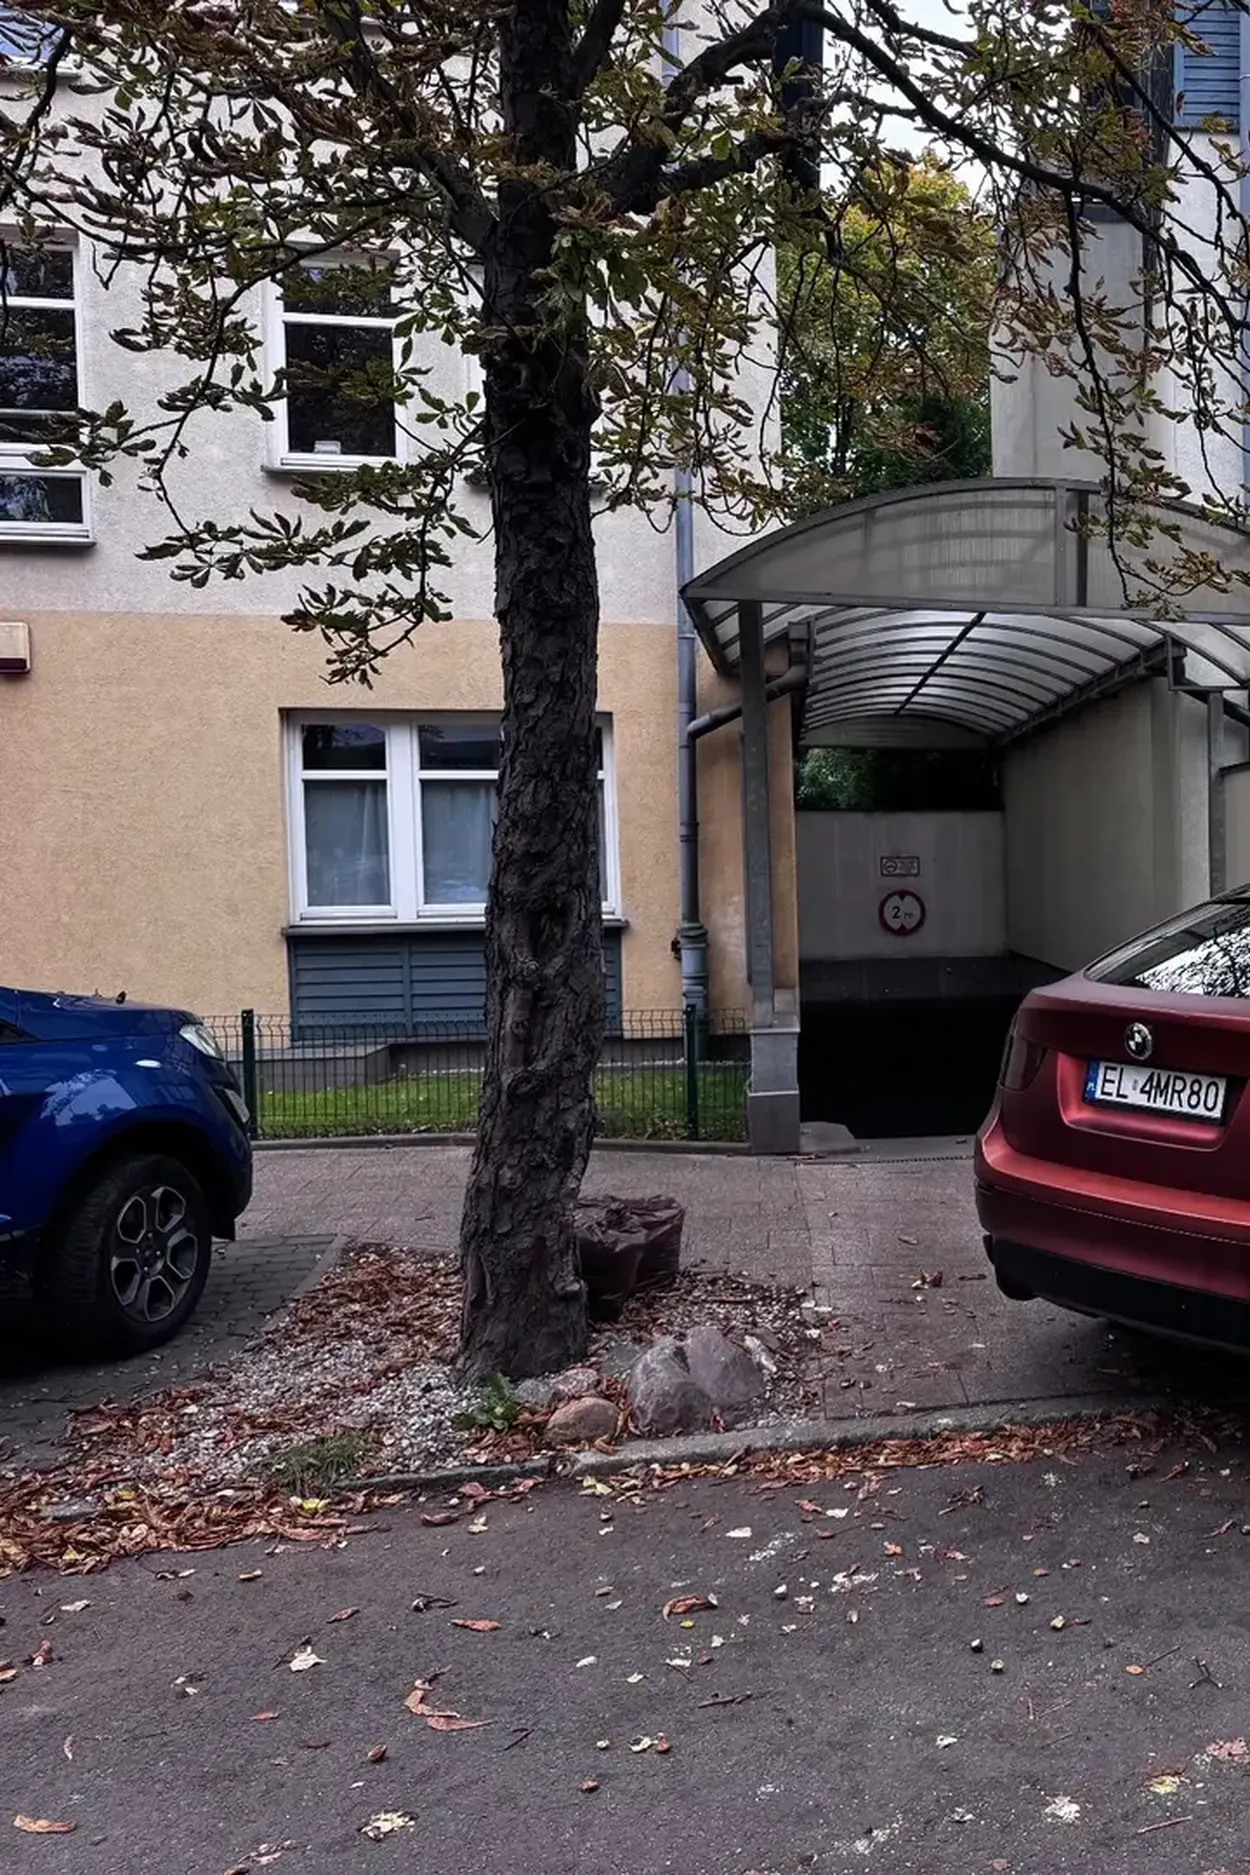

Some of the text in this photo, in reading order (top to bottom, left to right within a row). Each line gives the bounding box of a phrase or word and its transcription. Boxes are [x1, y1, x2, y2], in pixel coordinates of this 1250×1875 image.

[892, 905, 900, 919] 2
[1101, 1066, 1219, 1112] EL 4MR80
